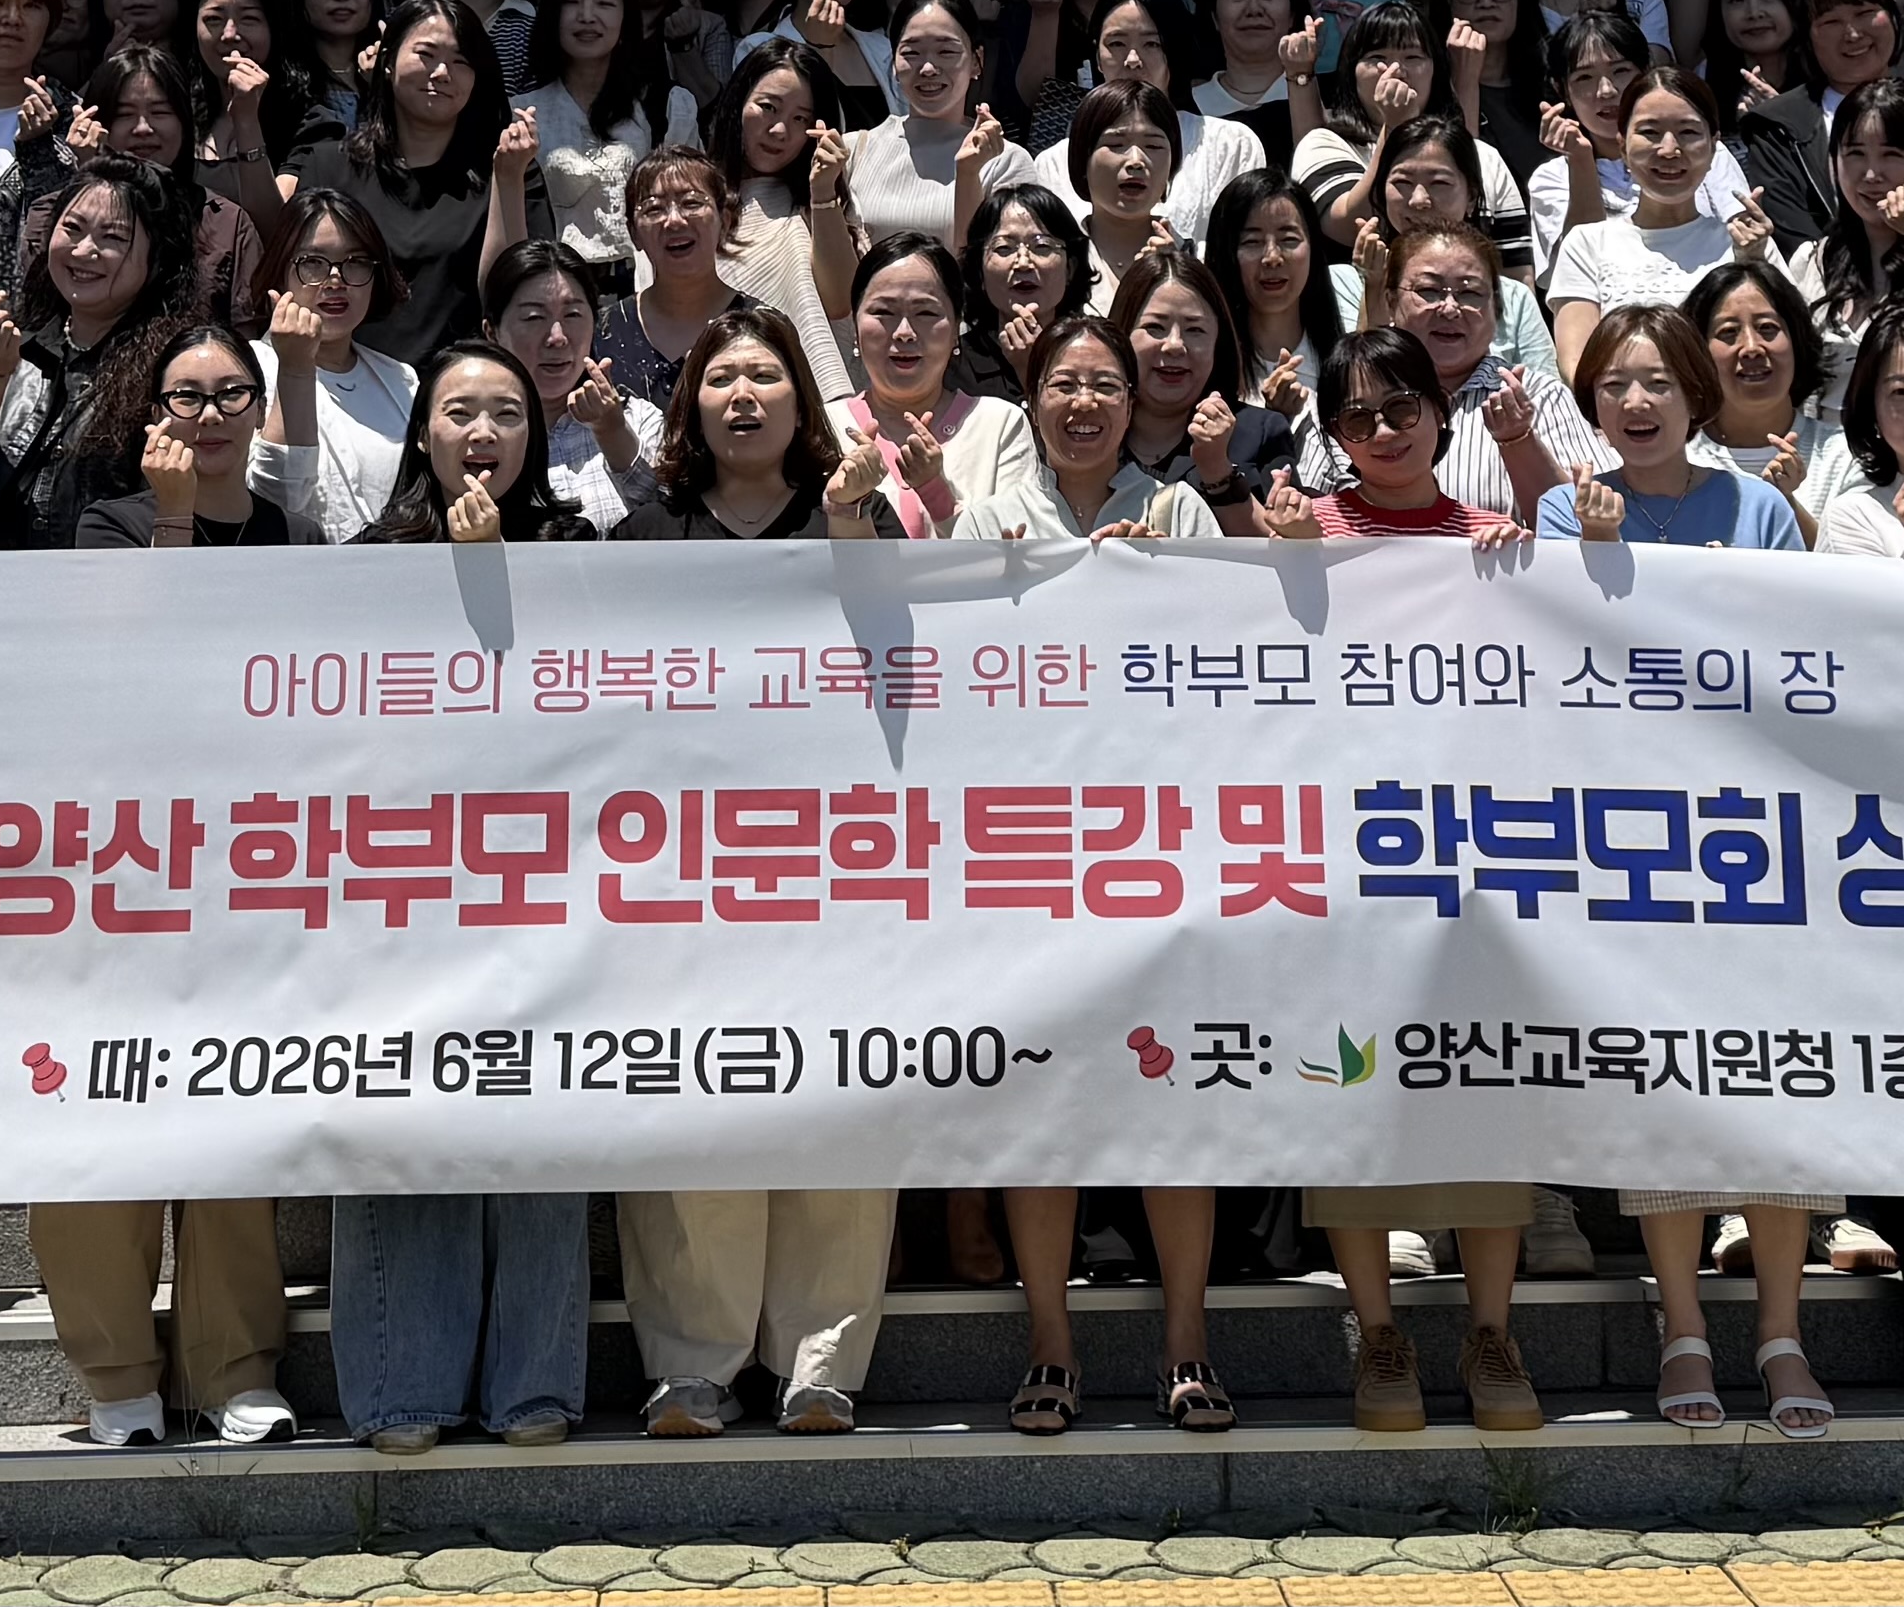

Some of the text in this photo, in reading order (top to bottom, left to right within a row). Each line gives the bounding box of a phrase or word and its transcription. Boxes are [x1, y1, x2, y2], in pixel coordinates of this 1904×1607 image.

[242, 642, 1845, 718] 아이들의 행복한 교육을 위한 학부모 참여와 소통의 장
[228, 791, 570, 930] 학부모
[597, 783, 941, 924] 인문학
[963, 784, 1193, 919] 특강
[1217, 784, 1328, 918] 및
[1353, 779, 1808, 926] 학부모회
[87, 1037, 171, 1104] 때:
[186, 1030, 413, 1098] 2026년
[432, 1029, 534, 1097] 6월
[829, 1025, 1053, 1090] 10:00~
[1190, 1022, 1273, 1090] 곳:
[1394, 1021, 1836, 1098] 양산교육지원청
